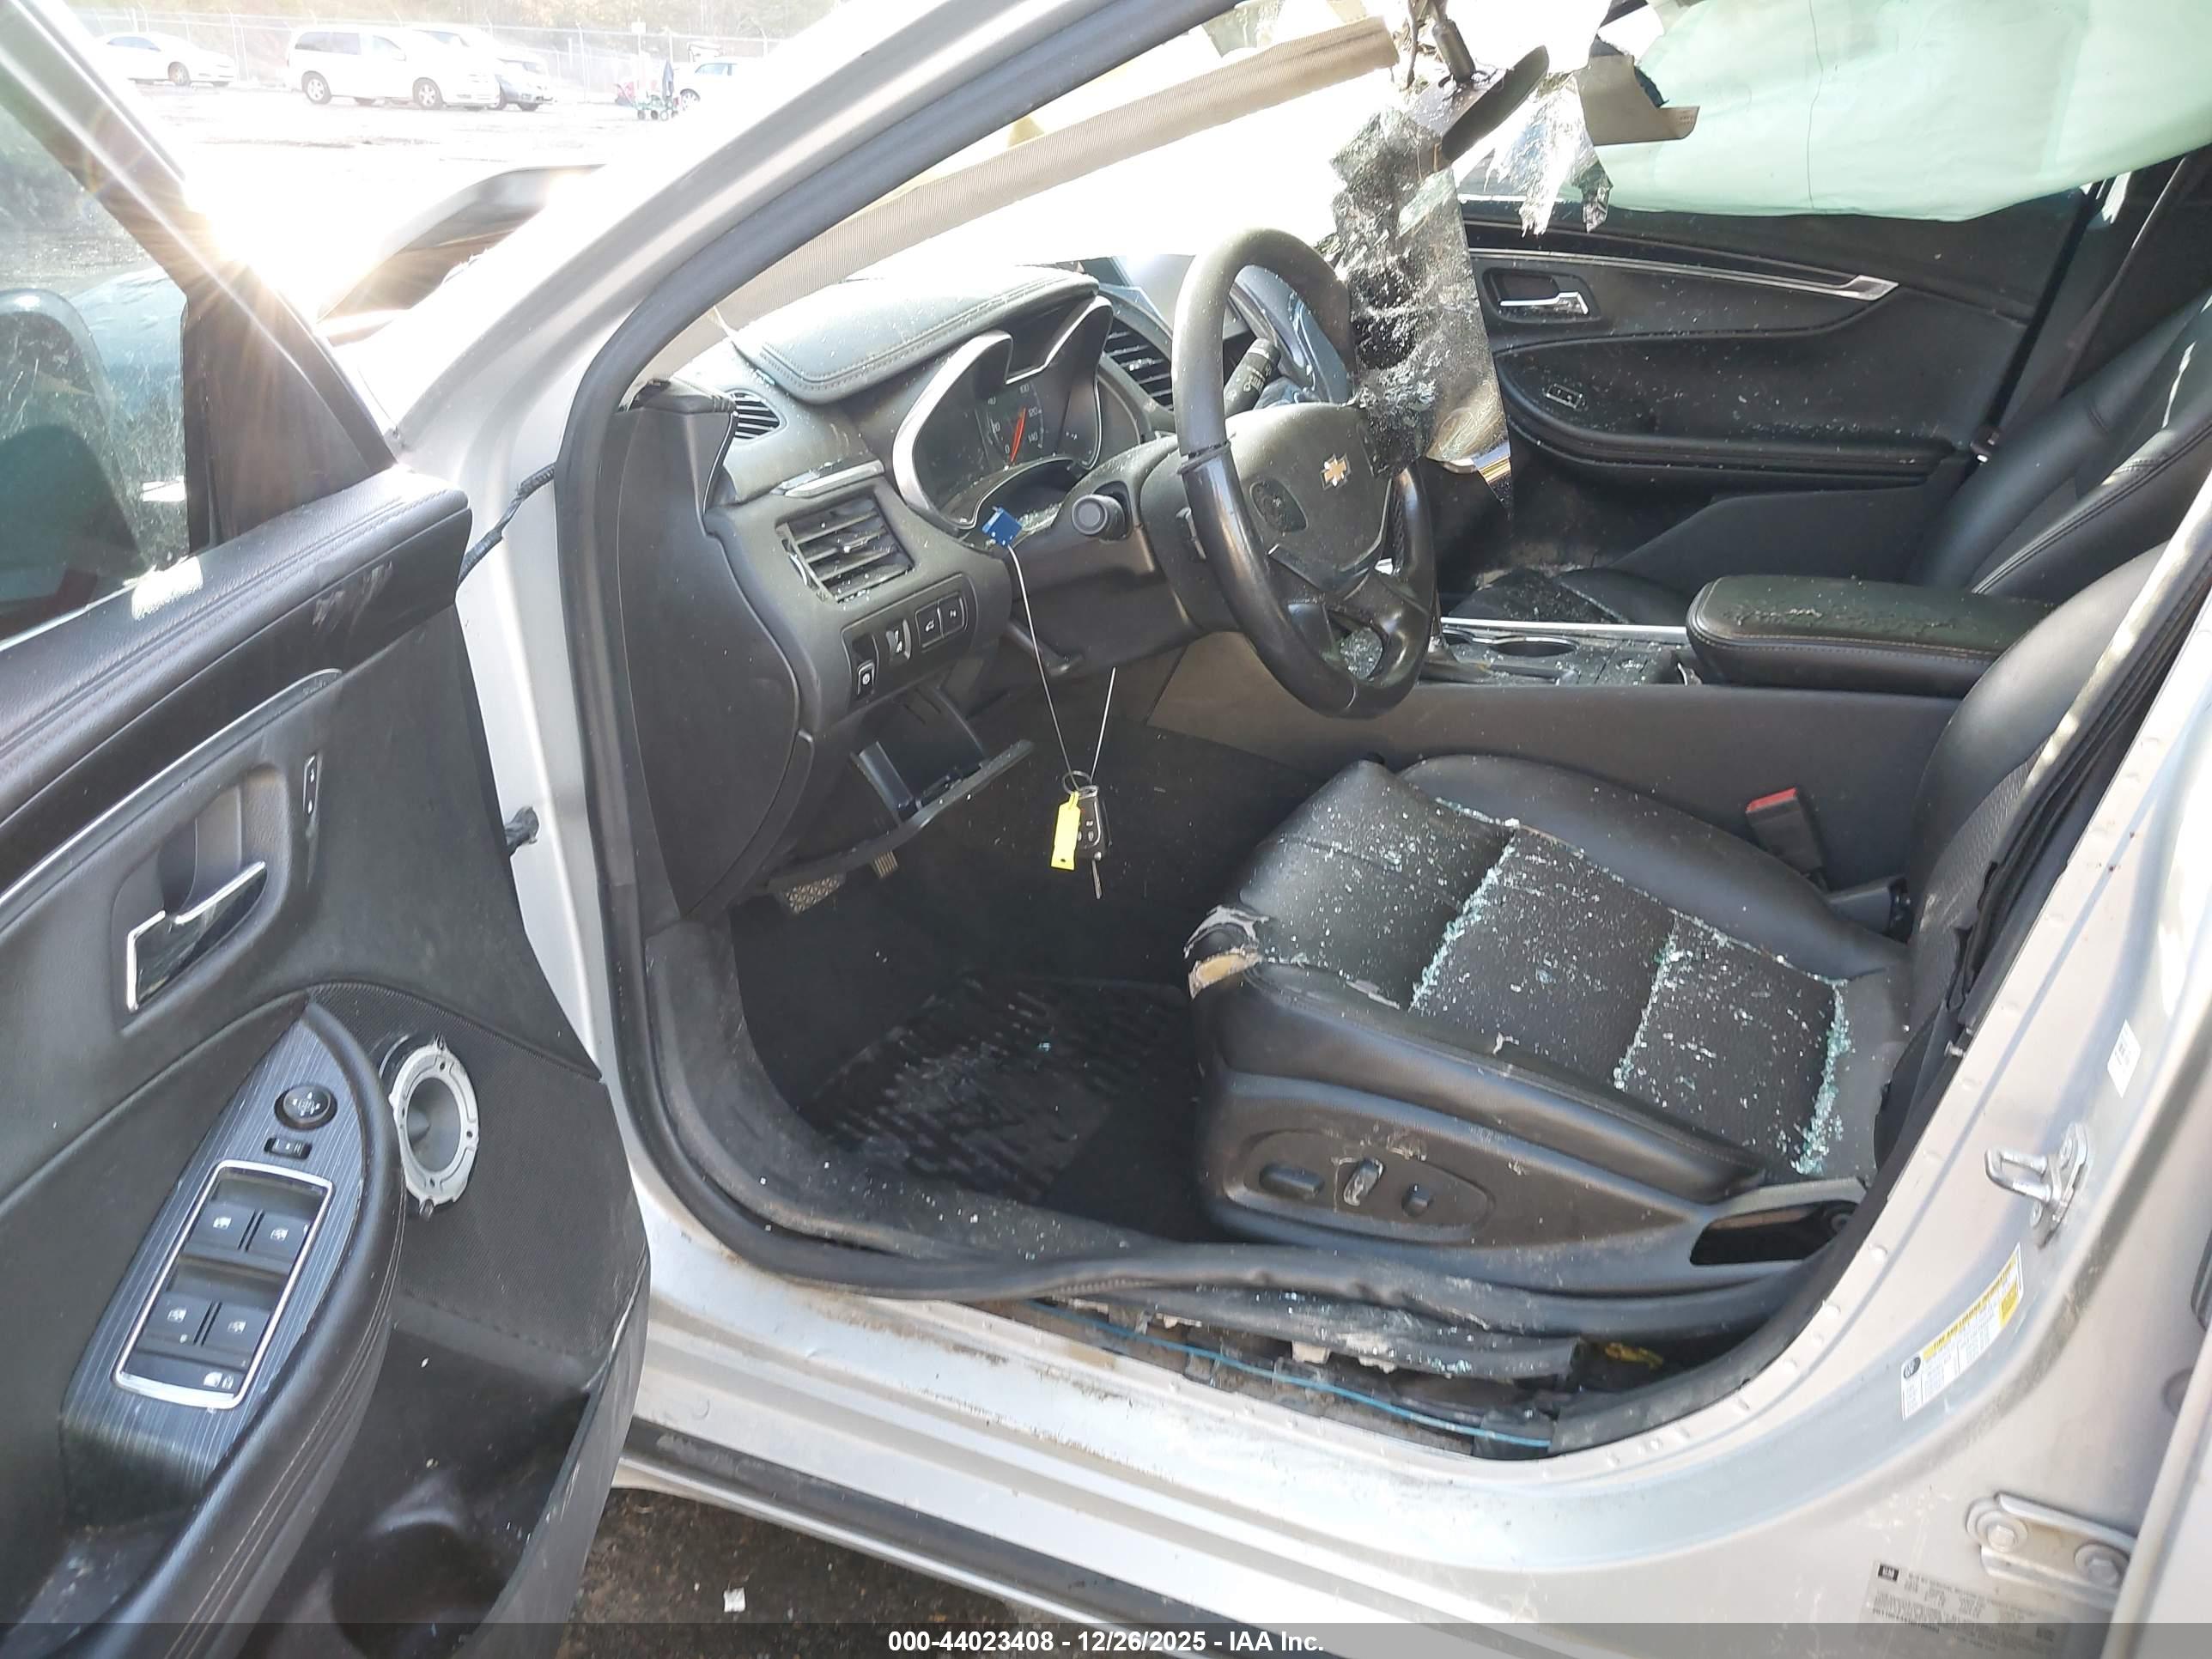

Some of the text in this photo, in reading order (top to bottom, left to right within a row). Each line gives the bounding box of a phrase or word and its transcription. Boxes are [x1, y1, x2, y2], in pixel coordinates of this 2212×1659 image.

[1019, 384, 1030, 393] 100
[1028, 407, 1037, 417] 120
[1028, 432, 1037, 443] 140
